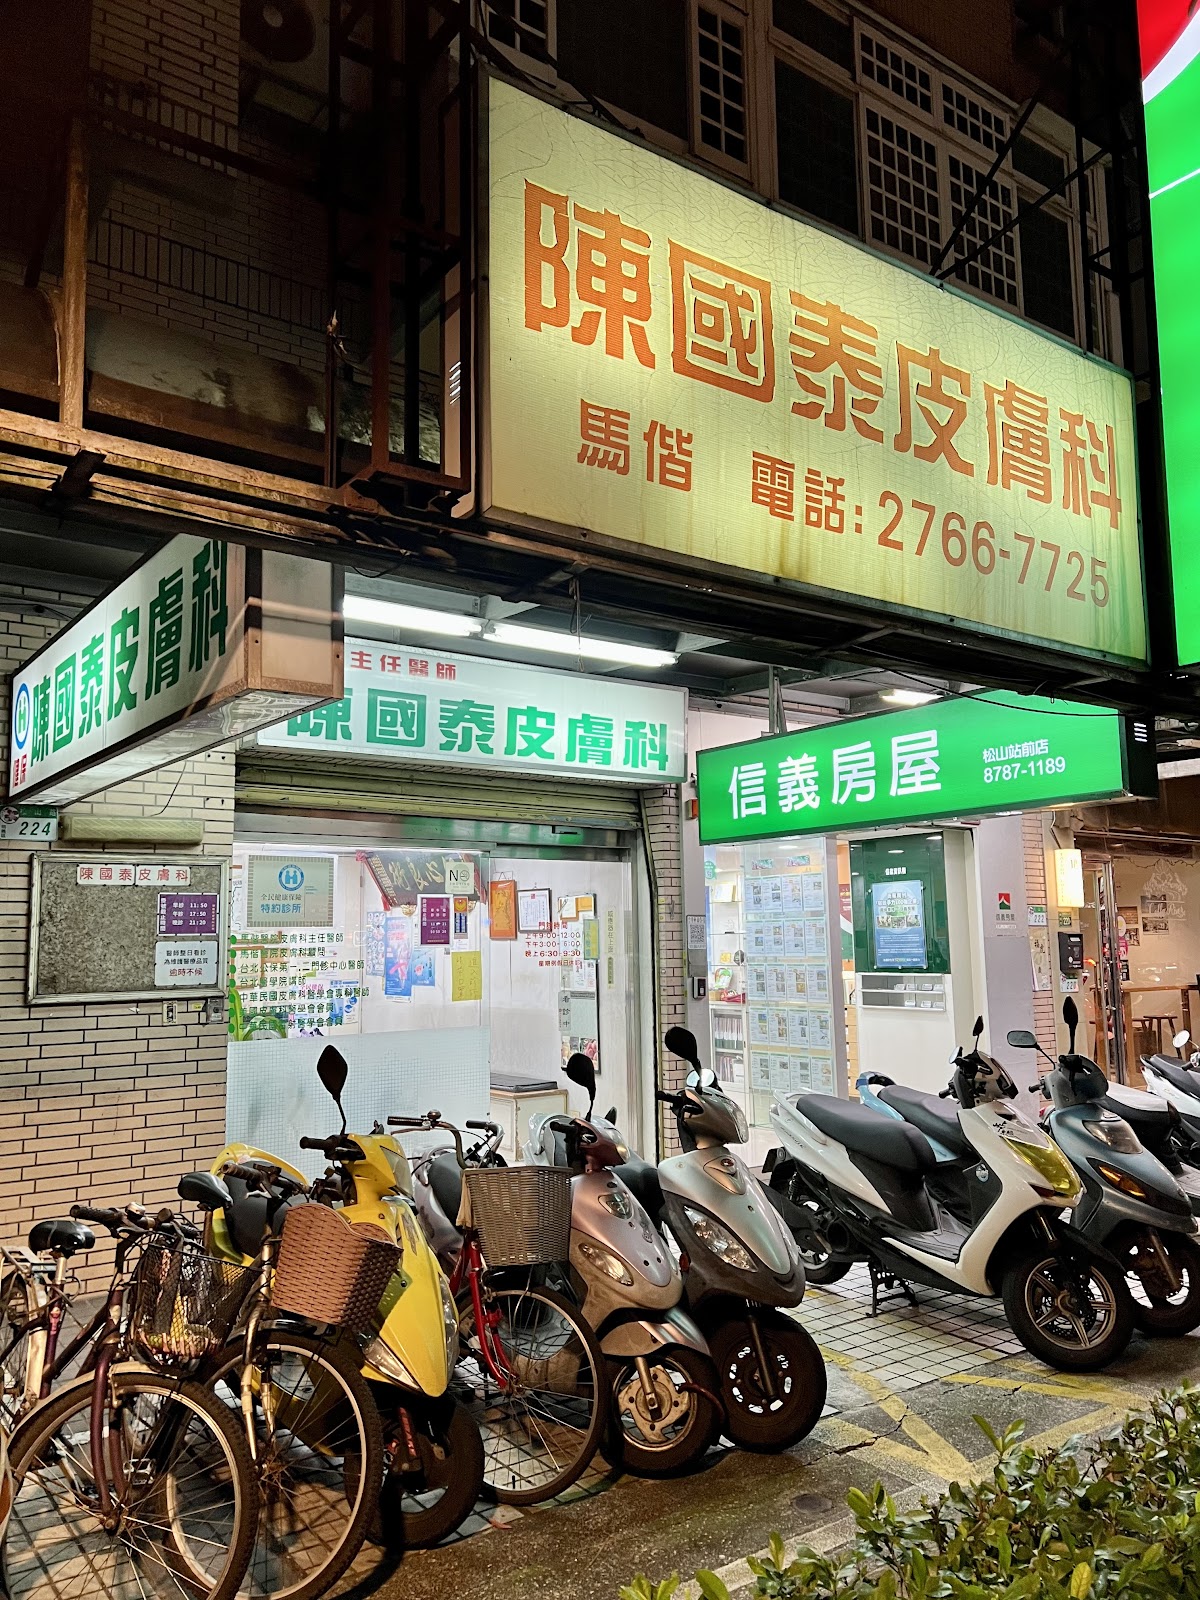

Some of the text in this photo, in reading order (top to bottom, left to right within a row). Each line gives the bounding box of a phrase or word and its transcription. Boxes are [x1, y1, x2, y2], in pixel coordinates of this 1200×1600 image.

[524, 178, 1121, 530] 陳國泰皮膚科
[577, 398, 694, 492] 馬偕
[31, 540, 228, 767] 陳國泰皮膚科
[350, 651, 456, 680] 主任醫師
[982, 738, 1049, 763] 松山站前店
[728, 729, 942, 819] 信義房屋
[983, 756, 1066, 783] 8787-1189
[19, 821, 51, 836] 224
[79, 867, 188, 882] 陳國泰皮膚科
[260, 903, 302, 914] 特約診所
